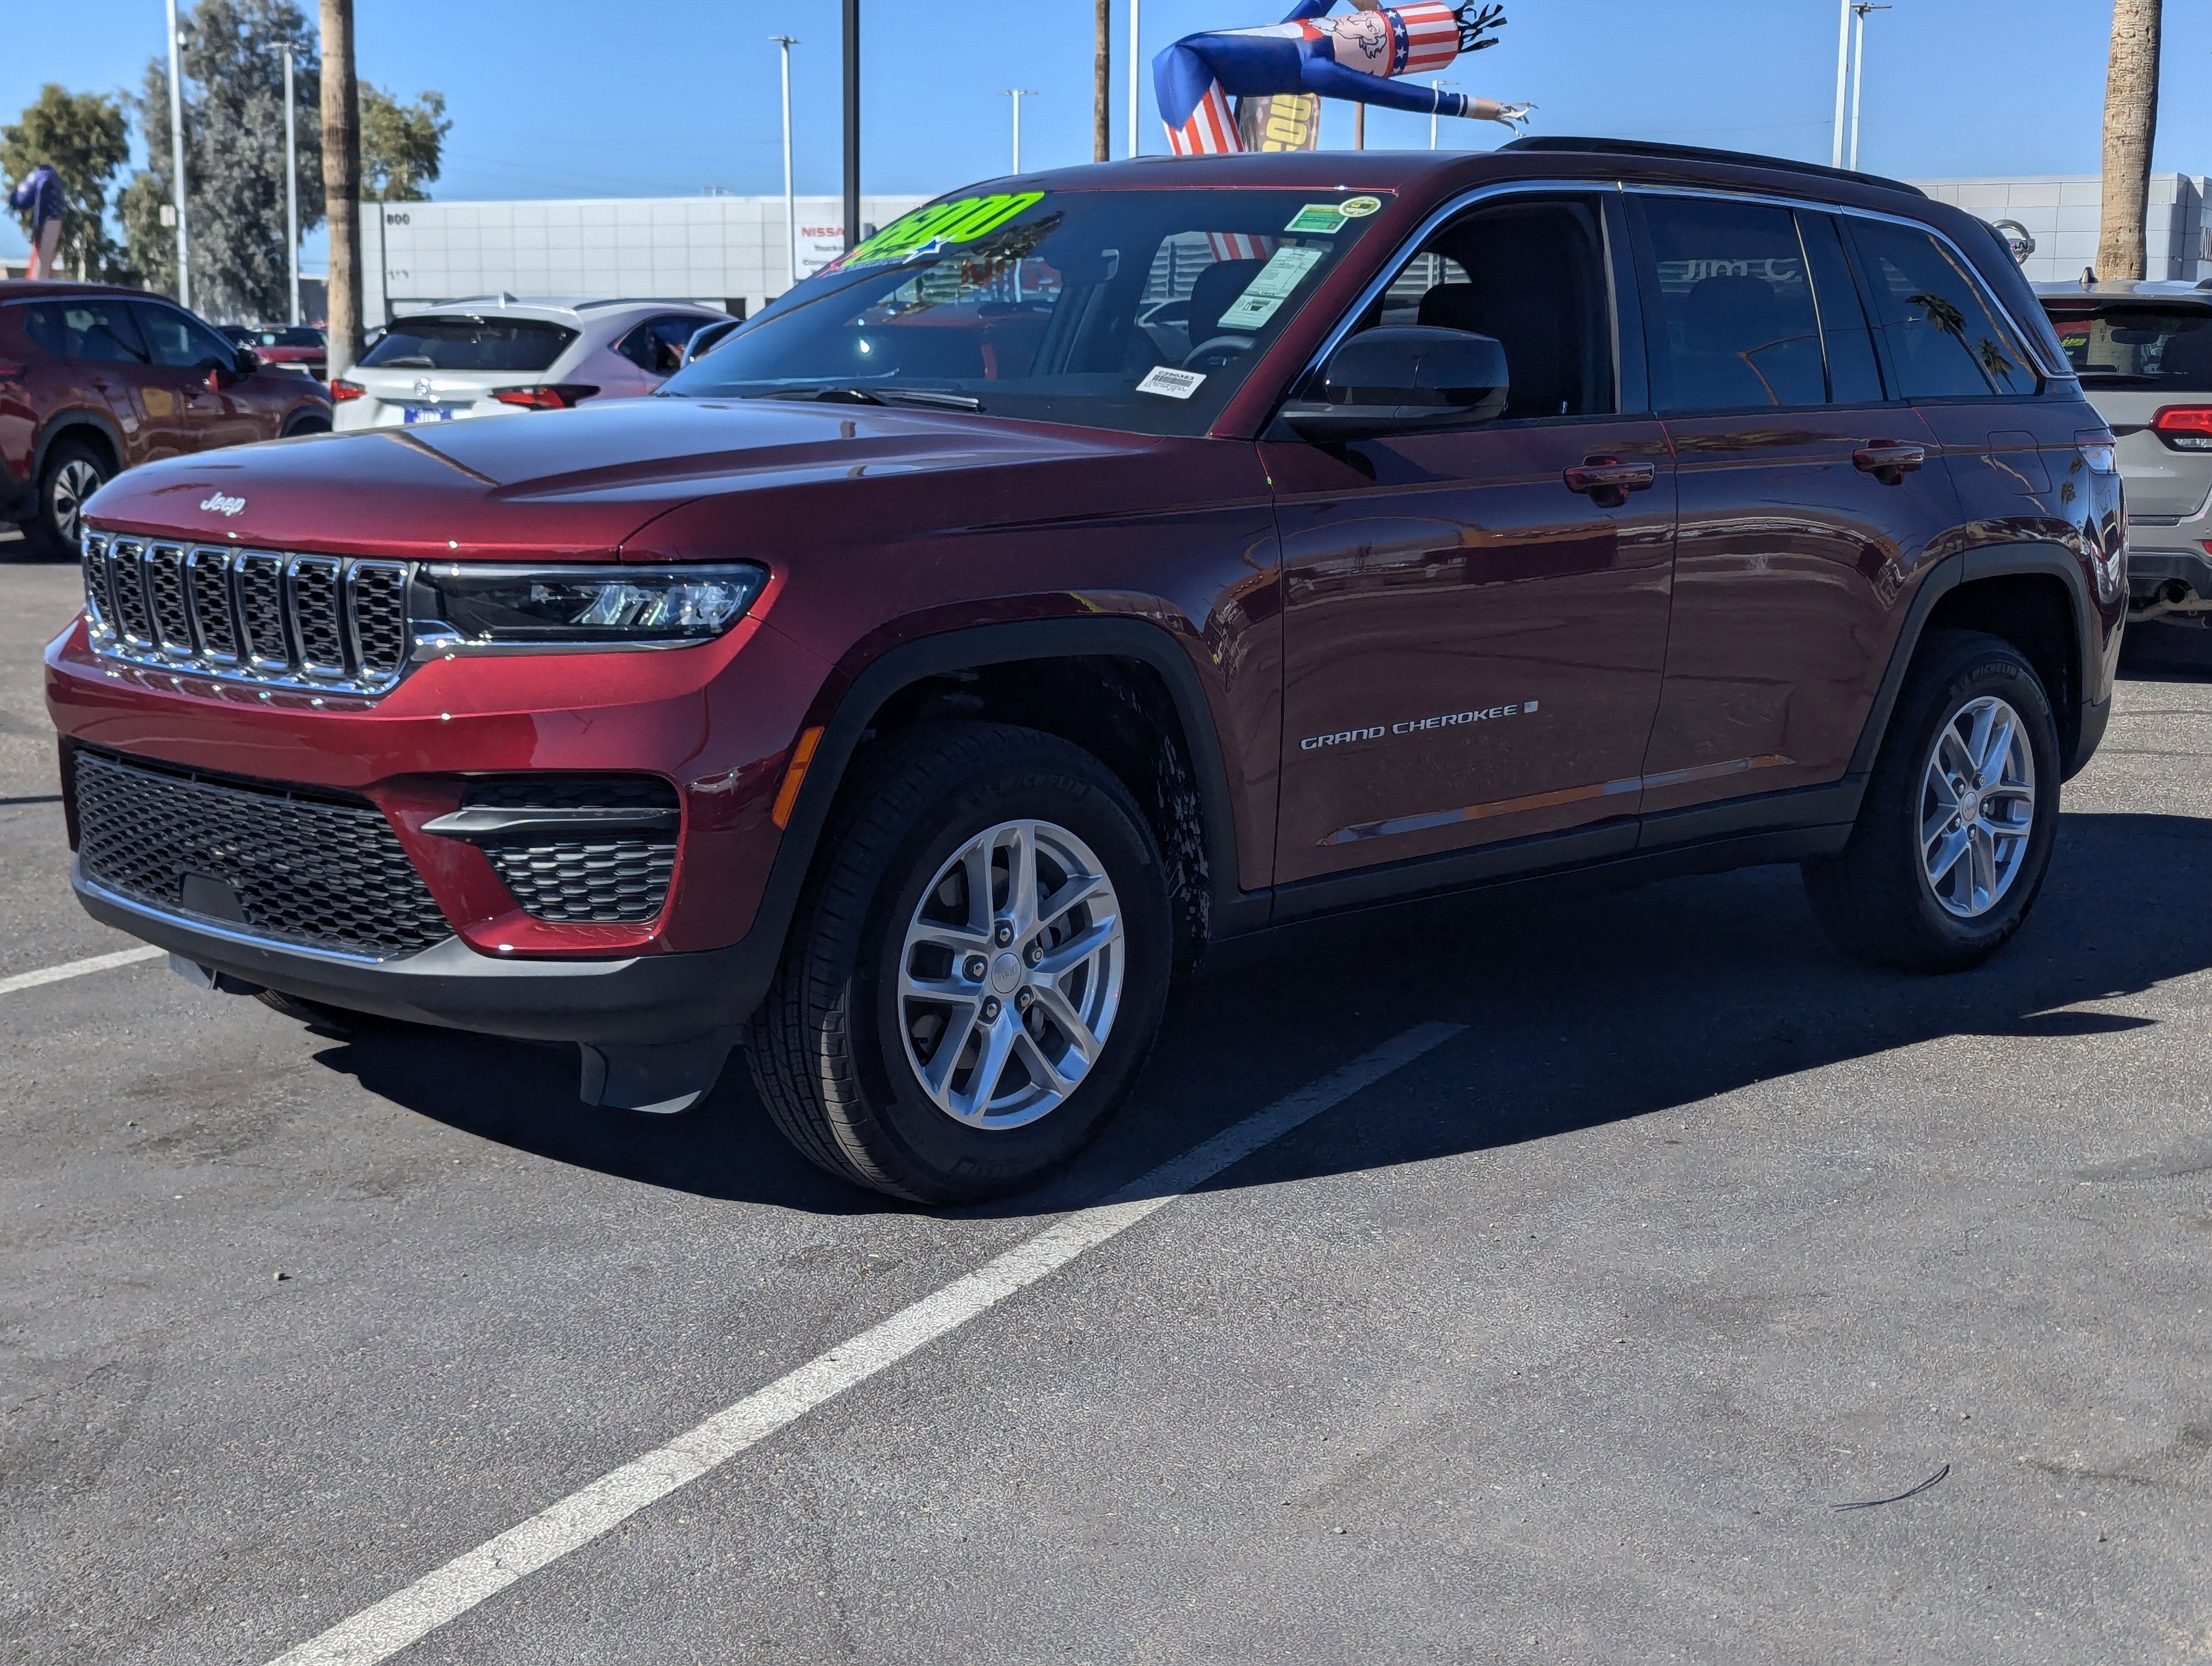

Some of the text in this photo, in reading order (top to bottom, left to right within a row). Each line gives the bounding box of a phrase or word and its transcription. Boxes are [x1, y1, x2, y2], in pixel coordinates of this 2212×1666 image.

[801, 227, 844, 238] NISSA
[200, 491, 246, 517] Jeep
[1301, 704, 1517, 750] GRAND CHEROKEE
